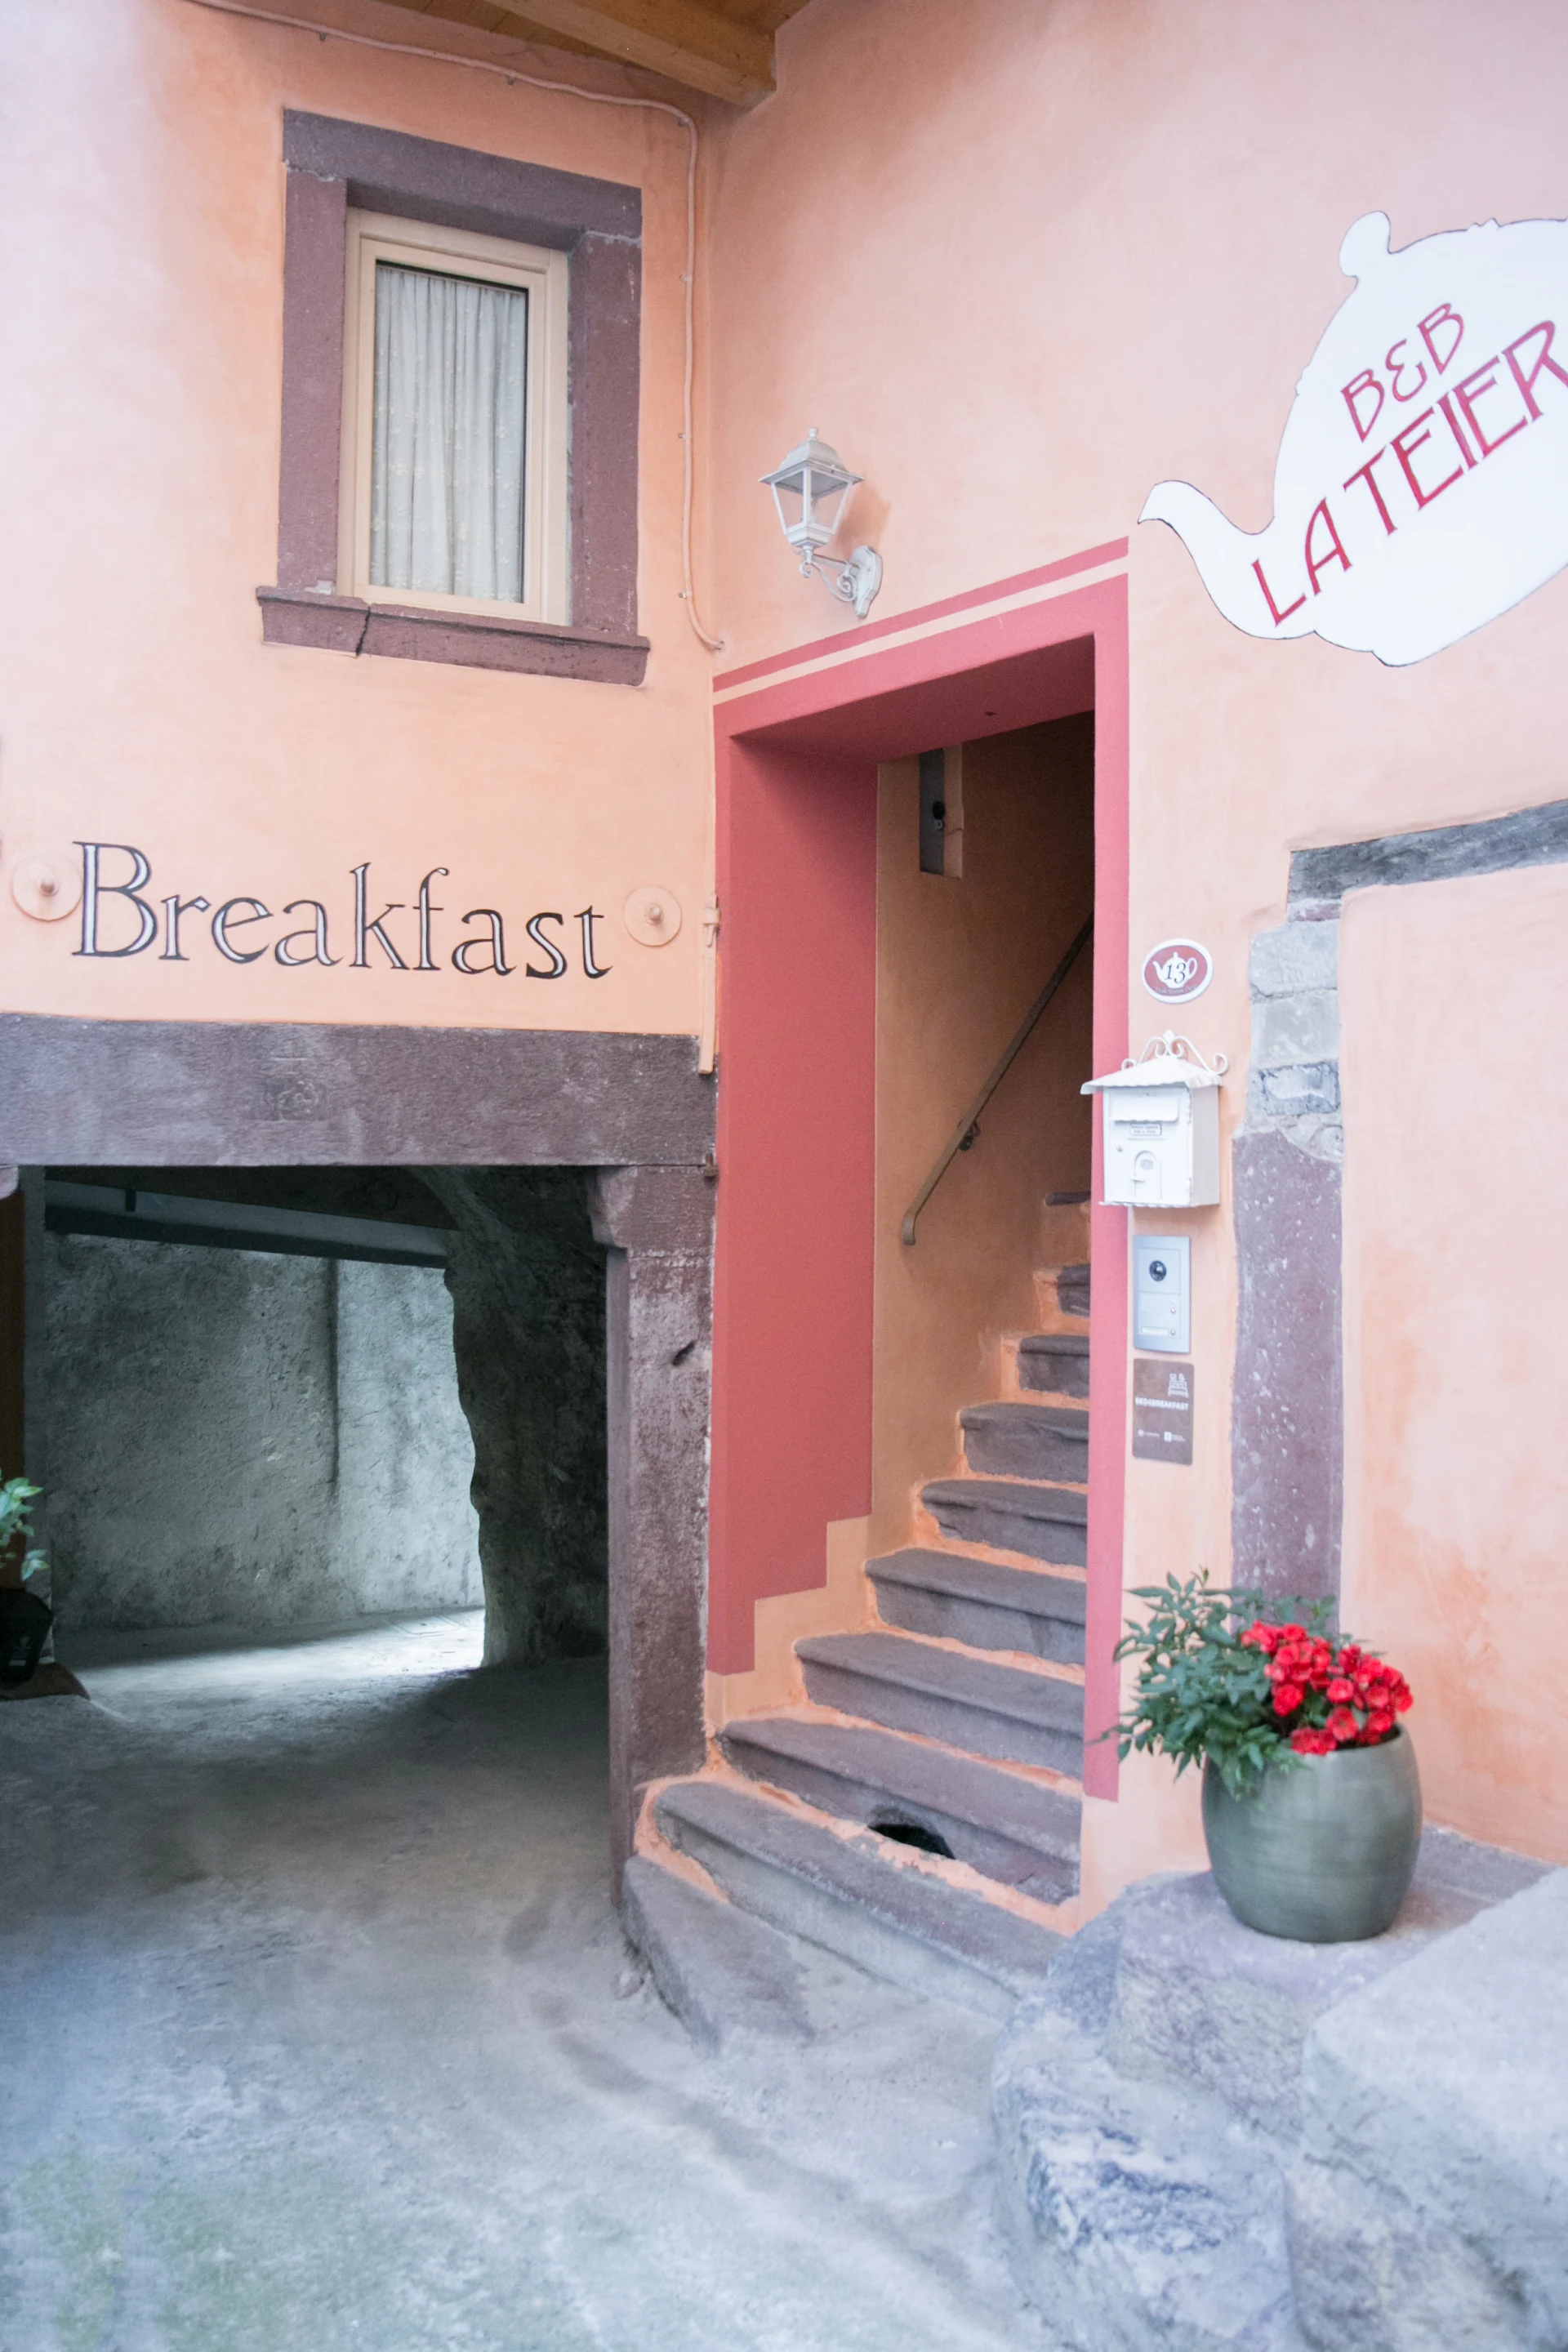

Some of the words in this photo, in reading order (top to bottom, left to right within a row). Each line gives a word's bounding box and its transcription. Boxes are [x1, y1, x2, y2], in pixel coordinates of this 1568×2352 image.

[1340, 302, 1464, 443] B&B
[72, 840, 613, 980] Breakfast
[1165, 963, 1187, 983] 13
